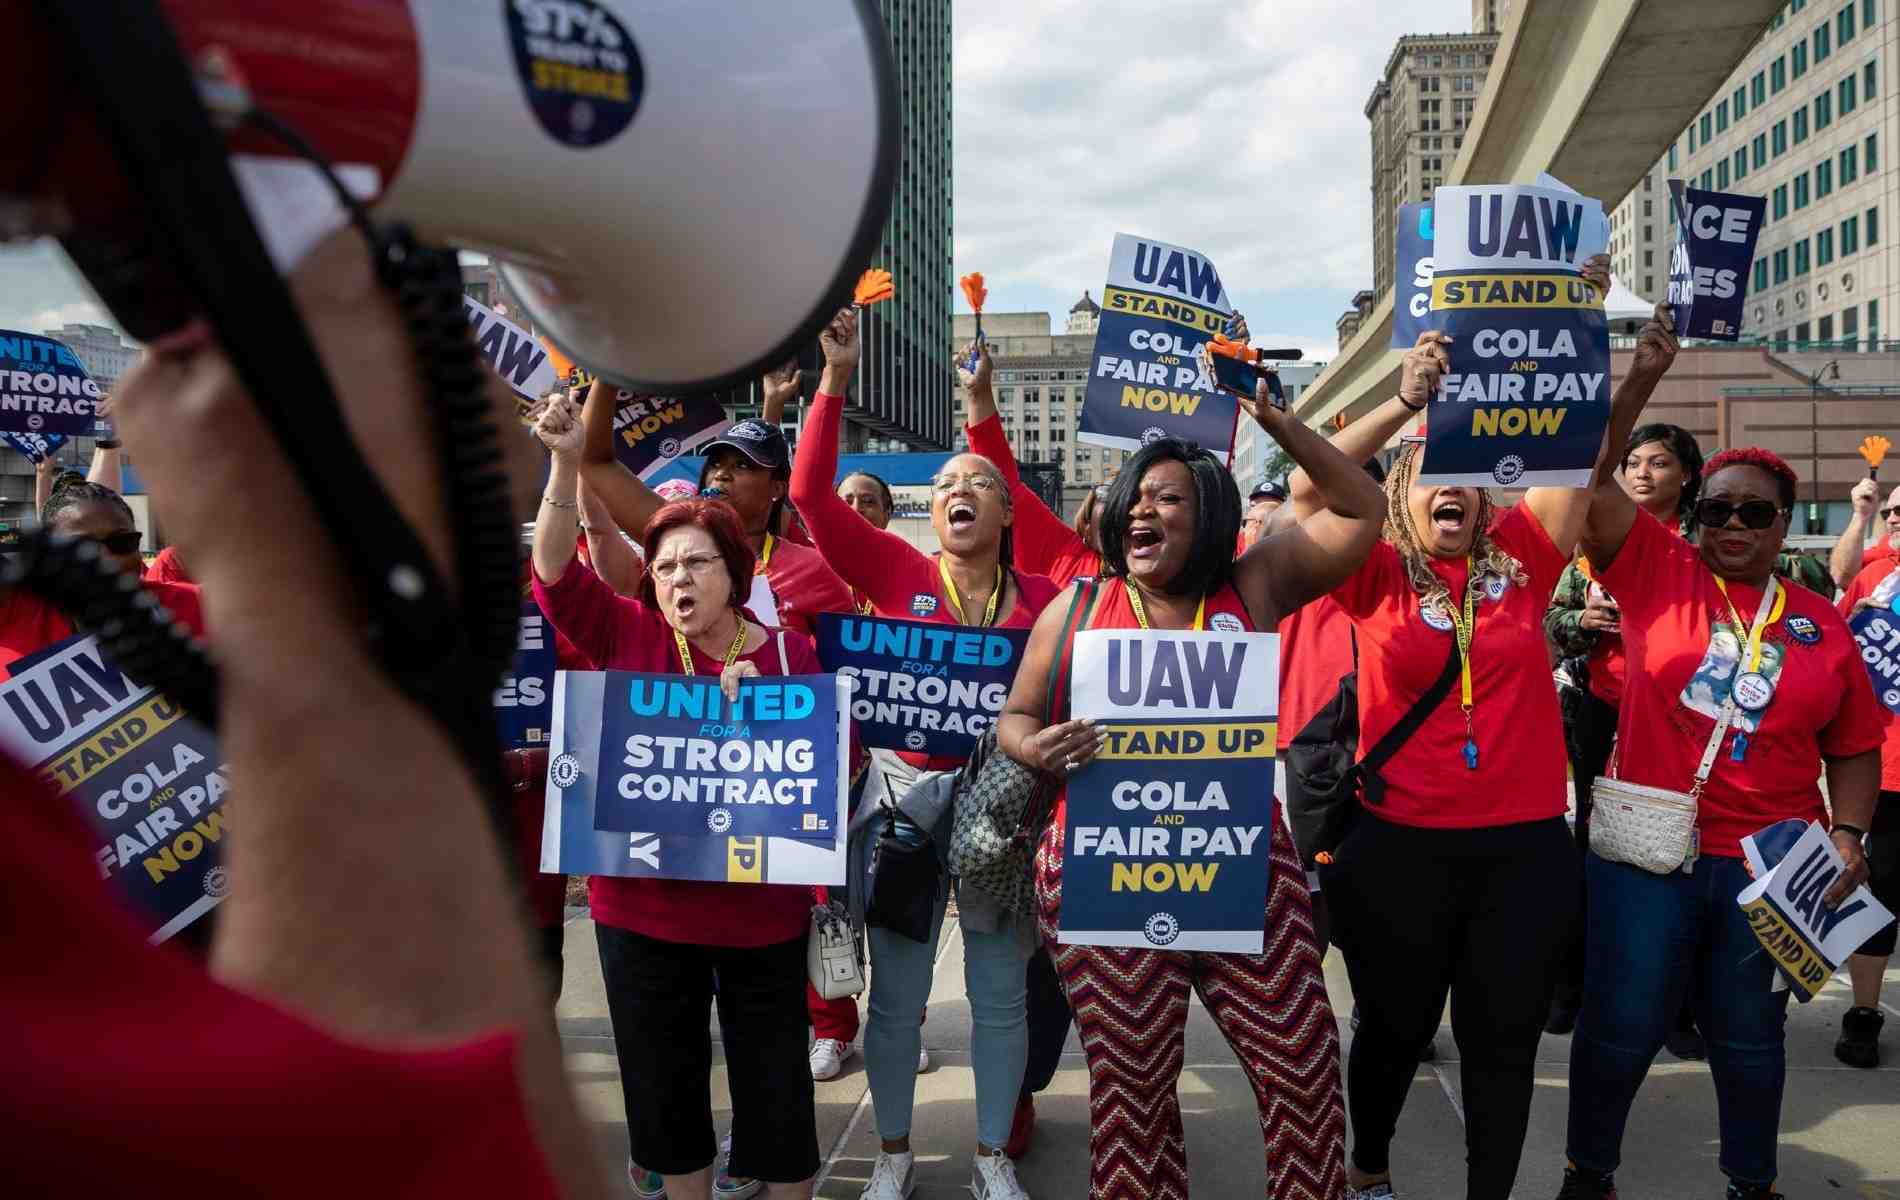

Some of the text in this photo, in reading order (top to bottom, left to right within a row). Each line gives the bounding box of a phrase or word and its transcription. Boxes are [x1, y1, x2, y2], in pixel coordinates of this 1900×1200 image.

[1467, 194, 1584, 265] UAW
[1133, 242, 1224, 305] UAW
[1444, 280, 1596, 305] STAND UP
[1111, 293, 1227, 334] STAND U
[1472, 329, 1578, 359] COLA
[1096, 356, 1227, 396] FAIR PA
[1155, 355, 1181, 366] AND
[1510, 360, 1538, 372] AND
[1120, 385, 1202, 417] NOW
[1437, 373, 1605, 403] FAIR PAY
[622, 402, 685, 448] NOW
[1471, 408, 1568, 437] NOW
[840, 619, 1013, 667] UNITED
[900, 661, 949, 677] FOR A
[1107, 638, 1248, 710] UAW
[630, 679, 816, 721] UNITED
[699, 724, 751, 738] FOR A
[1103, 729, 1265, 755] TAND UP
[623, 735, 815, 773] STRONG
[97, 743, 205, 820] COLA
[617, 773, 818, 805] CONTRACT
[1111, 780, 1231, 811] COLA
[150, 787, 176, 811] AND
[1153, 814, 1185, 826] AND
[95, 806, 183, 880] FAIR
[1073, 826, 1264, 857] FAIR PAY
[1111, 862, 1220, 892] NOW
[1785, 844, 1868, 944] UAW
[1746, 906, 1825, 985] STAND UP
